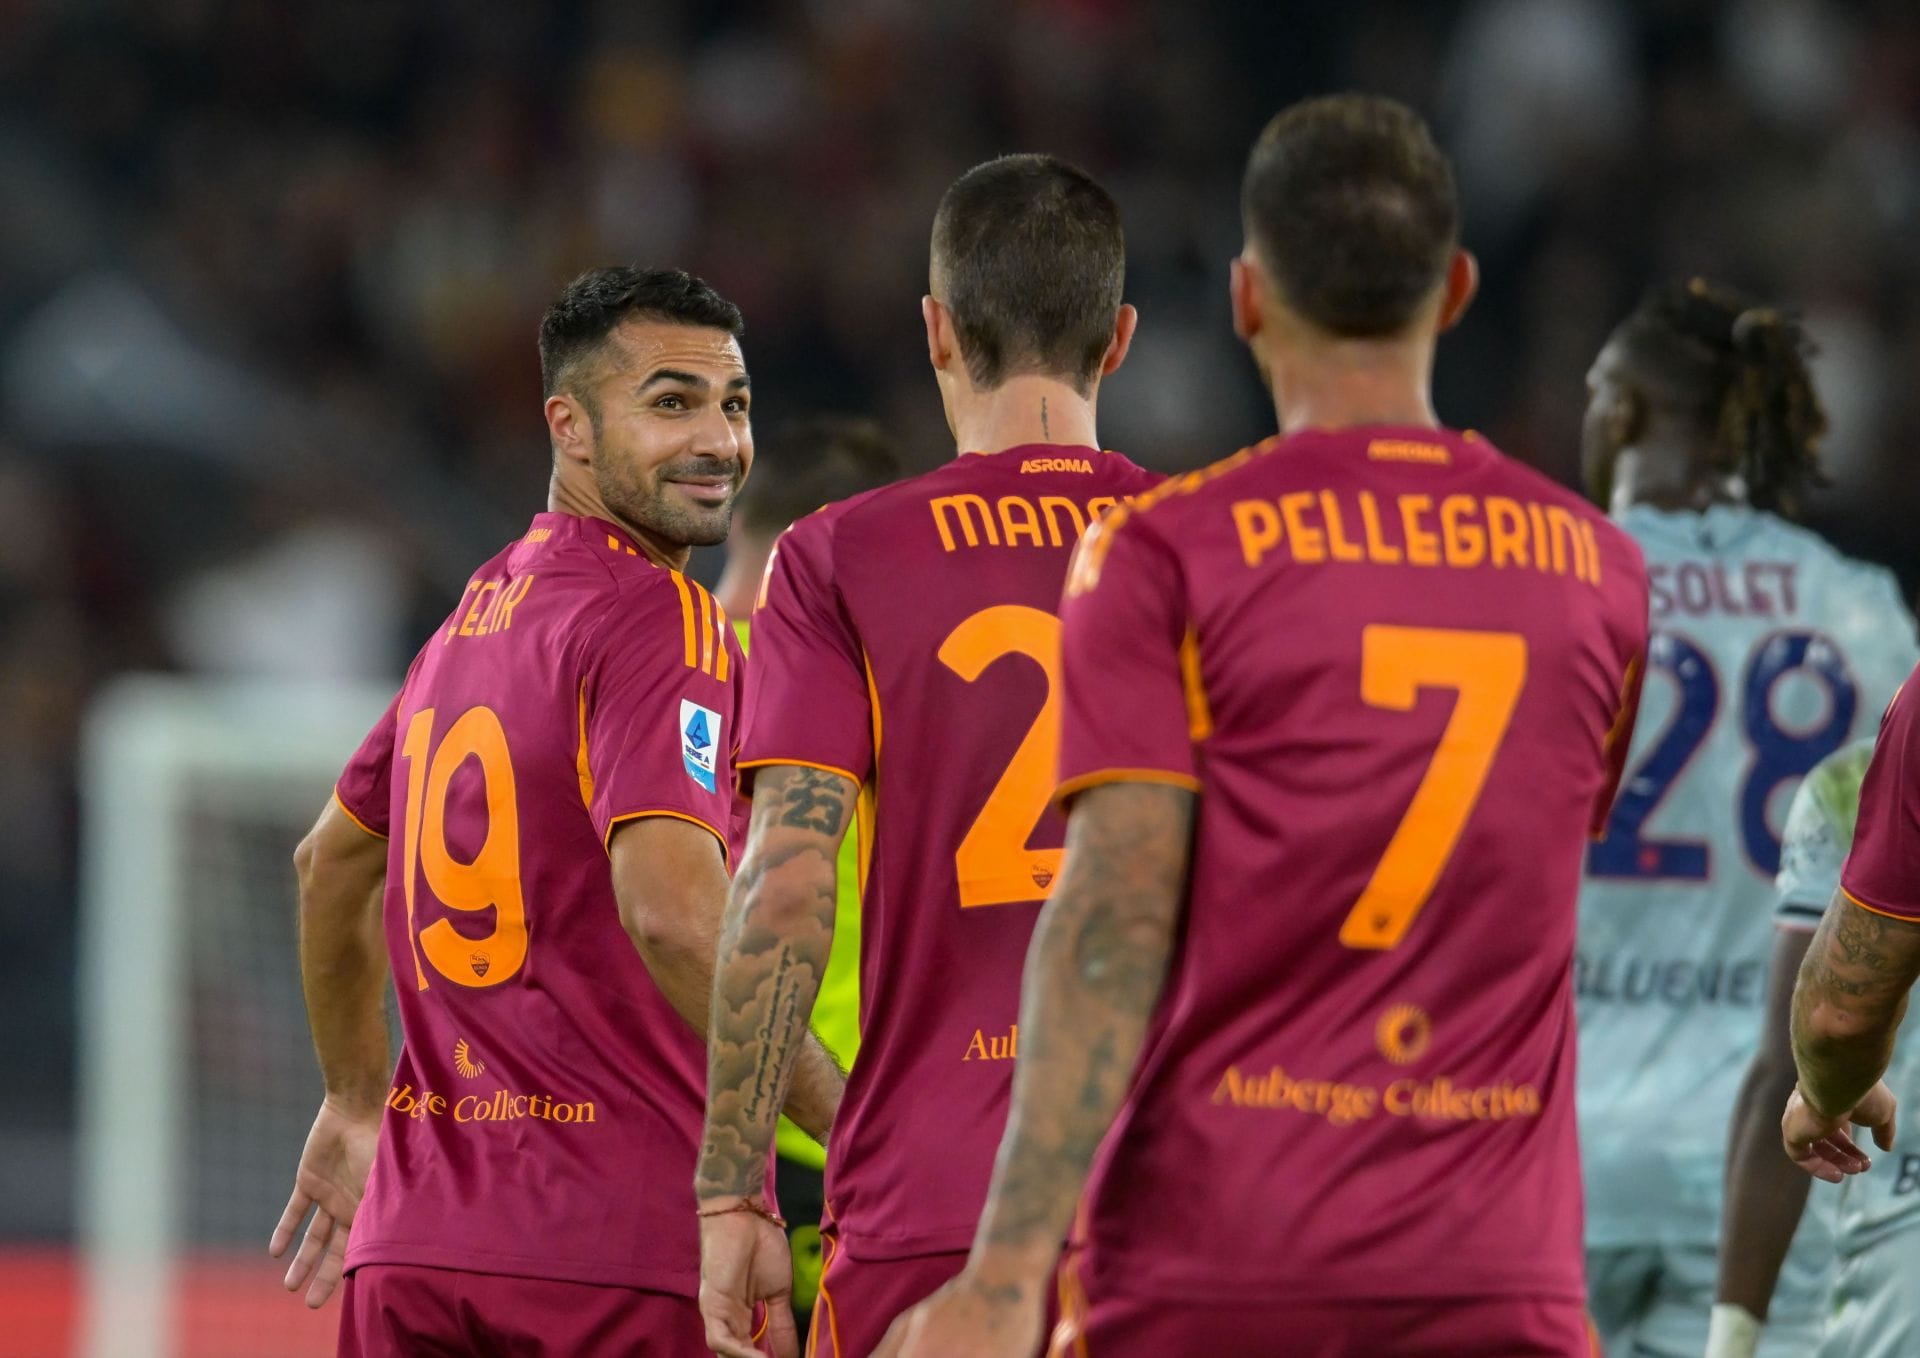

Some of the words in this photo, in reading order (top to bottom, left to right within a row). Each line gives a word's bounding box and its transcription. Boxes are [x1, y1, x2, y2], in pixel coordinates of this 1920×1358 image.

[1020, 458, 1094, 475] ASROMA
[1231, 488, 1601, 587] PELLEGRINI
[1338, 623, 1528, 950] 7
[1586, 628, 1860, 883] 28
[402, 705, 528, 992] 19
[453, 1089, 597, 1124] Collection
[1211, 1065, 1379, 1127] Auberge
